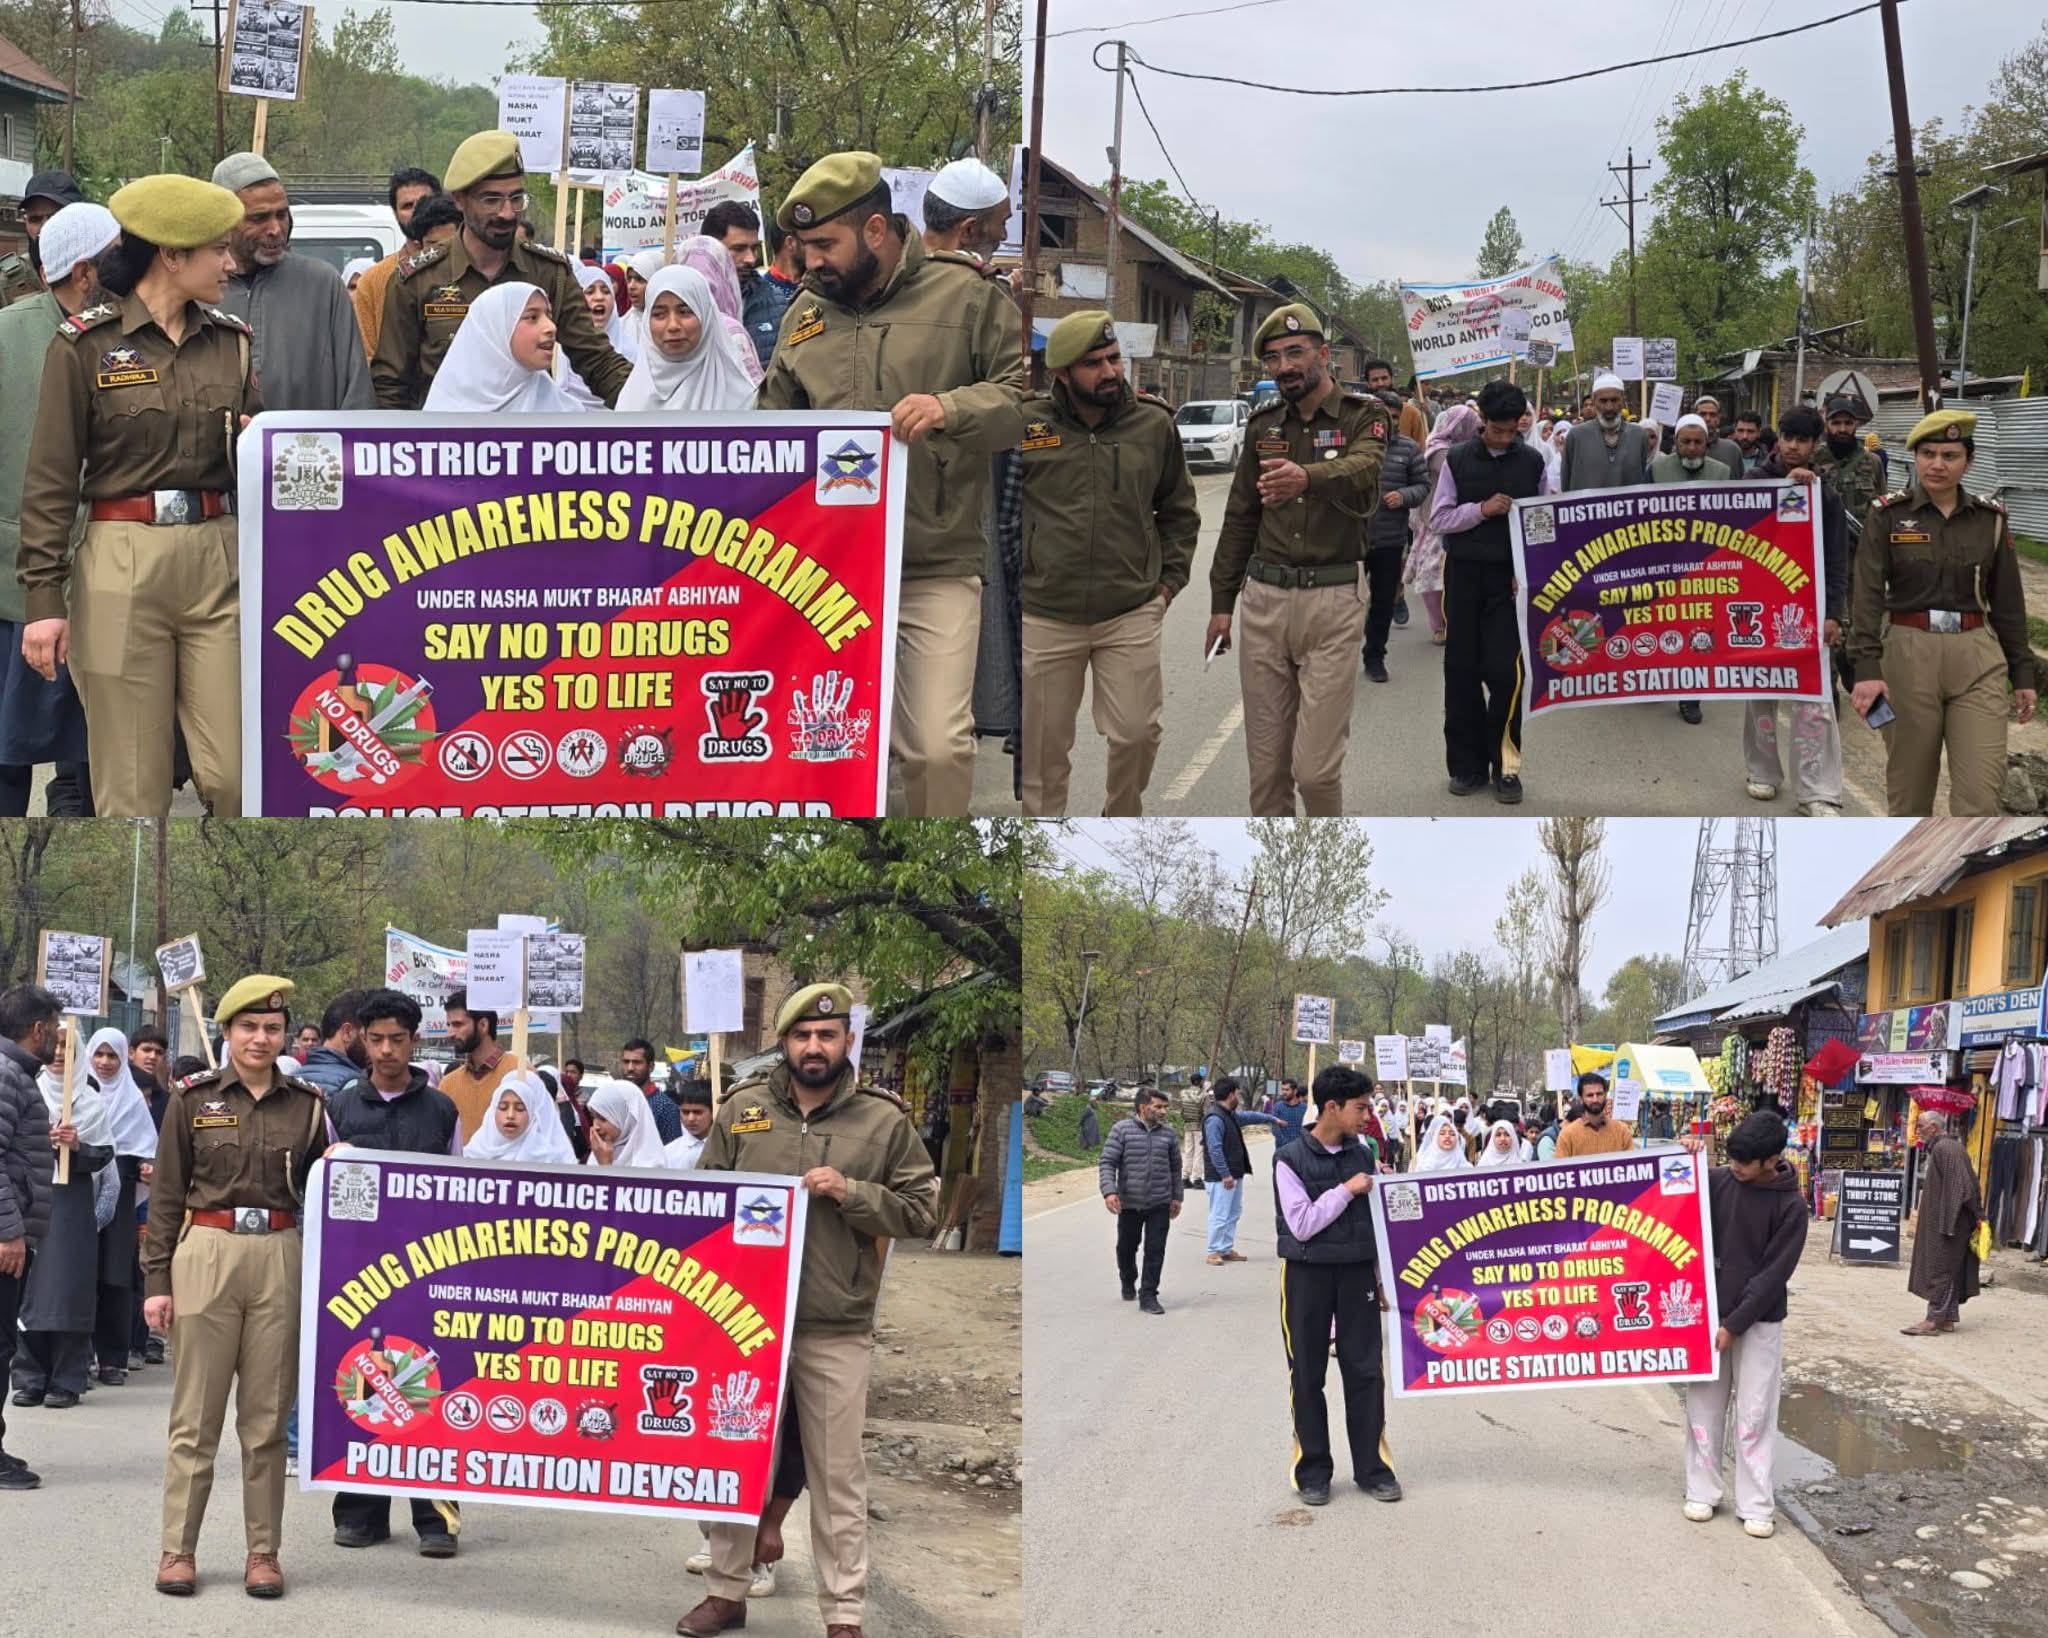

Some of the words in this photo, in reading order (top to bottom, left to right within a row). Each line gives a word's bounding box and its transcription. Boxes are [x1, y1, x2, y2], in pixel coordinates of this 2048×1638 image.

[506, 116, 532, 124] MUKT
[507, 102, 538, 111] NASHA
[513, 131, 542, 139] HARAT
[604, 216, 646, 229] WORLD
[650, 215, 679, 228] ANI
[1426, 294, 1452, 313] BOYS
[1411, 333, 1456, 353] WORLD
[1459, 326, 1489, 345] ANTI
[353, 441, 523, 477] DISTRICT
[531, 441, 653, 475] POLICE
[661, 439, 805, 474] KULGAM
[1558, 499, 1634, 524] DISTRICT
[1638, 495, 1696, 515] POLICE
[1700, 492, 1772, 511] KULGAM
[272, 551, 391, 659] DRUG
[382, 490, 631, 584] AWARENESS
[639, 495, 872, 653] PROGRAMME
[1532, 559, 1582, 613] DRUG
[1575, 518, 1687, 573] AWARENESS
[1690, 519, 1810, 594] PROGRAMME
[1592, 573, 1620, 584] UNDER
[1620, 568, 1647, 580] NASHA
[1672, 562, 1704, 574] BHARAT
[416, 590, 476, 609] UNDER
[480, 589, 539, 609] NASHA
[543, 588, 593, 608] MUKT
[597, 587, 664, 607] BHARAT
[667, 585, 741, 606] ABHIYAN
[1599, 586, 1628, 606] SAY
[1630, 583, 1654, 602] NO
[1655, 580, 1676, 598] TO
[1680, 576, 1740, 596] DRUGS
[1623, 606, 1652, 626] YES
[1655, 603, 1677, 622] TO
[1680, 601, 1713, 620] LIFE
[424, 622, 491, 660] SAY
[498, 622, 548, 660] NO
[556, 621, 602, 659] TO
[610, 619, 730, 657] DRUGS
[1551, 625, 1565, 639] NO
[1563, 634, 1589, 661] DRUGS
[481, 674, 545, 711] YES
[553, 672, 599, 710] TO
[607, 671, 673, 709] LIFE
[708, 679, 730, 690] SAY
[733, 679, 748, 690] NO
[750, 678, 766, 689] TO
[1548, 671, 1618, 700] POLICE
[1622, 667, 1709, 694] STATION
[1713, 665, 1799, 690] DEVSAR
[315, 688, 346, 719] NO
[340, 715, 400, 776] DRUGS
[624, 752, 665, 765] DRUGS
[635, 740, 658, 754] NO
[706, 739, 764, 755] DRUGS
[410, 995, 434, 1007] RLD
[1963, 995, 2006, 1015] CTOR'S
[2010, 990, 2040, 1009] DEN
[425, 1020, 444, 1029] SAY
[387, 1172, 511, 1206] DISTRICT
[517, 1179, 609, 1211] POLICE
[615, 1186, 727, 1218] KULGAM
[1424, 1178, 1509, 1203] DISTRICT
[1513, 1170, 1576, 1197] POLICE
[1579, 1163, 1655, 1188] KULGAM
[1399, 1236, 1453, 1289] DRUG
[1445, 1196, 1567, 1251] AWARENESS
[1571, 1197, 1698, 1271] PROGRAMME
[1465, 1250, 1496, 1262] UNDER
[1497, 1247, 1526, 1259] NASHA
[1527, 1245, 1553, 1256] MUKT
[1590, 1239, 1628, 1251] ABHIYAN
[1472, 1265, 1504, 1285] SAY
[1508, 1262, 1533, 1283] NO
[1536, 1260, 1560, 1280] TO
[1563, 1257, 1625, 1278] DRUGS
[326, 1253, 411, 1330] DRUG
[405, 1218, 590, 1279] AWARENESS
[595, 1226, 776, 1358] PROGRAMME
[428, 1284, 472, 1301] UNDER
[475, 1287, 518, 1304] NASHA
[521, 1290, 559, 1307] MUKT
[561, 1293, 613, 1311] BHARAT
[615, 1296, 673, 1315] ABHIYAN
[1501, 1289, 1533, 1309] YES
[1536, 1286, 1560, 1306] TO
[1564, 1284, 1598, 1305] LIFE
[433, 1309, 483, 1340] SAY
[487, 1313, 525, 1343] NO
[531, 1316, 565, 1346] TO
[571, 1319, 664, 1353] DRUGS
[1424, 1303, 1439, 1318] NO
[1437, 1313, 1469, 1342] DRUGS
[473, 1351, 521, 1382] YES
[527, 1355, 561, 1385] TO
[567, 1358, 619, 1388] LIFE
[646, 1369, 662, 1379] SAY
[681, 1371, 692, 1380] TO
[1427, 1356, 1500, 1384] POLICE
[1506, 1351, 1595, 1379] STATION
[1601, 1347, 1687, 1374] DEVSAR
[354, 1353, 374, 1376] NO
[373, 1373, 416, 1422] DRUGS
[644, 1417, 690, 1431] DRUGS
[345, 1441, 459, 1484] POLICE
[465, 1450, 602, 1494] STATION
[608, 1462, 740, 1505] DEVSAR
